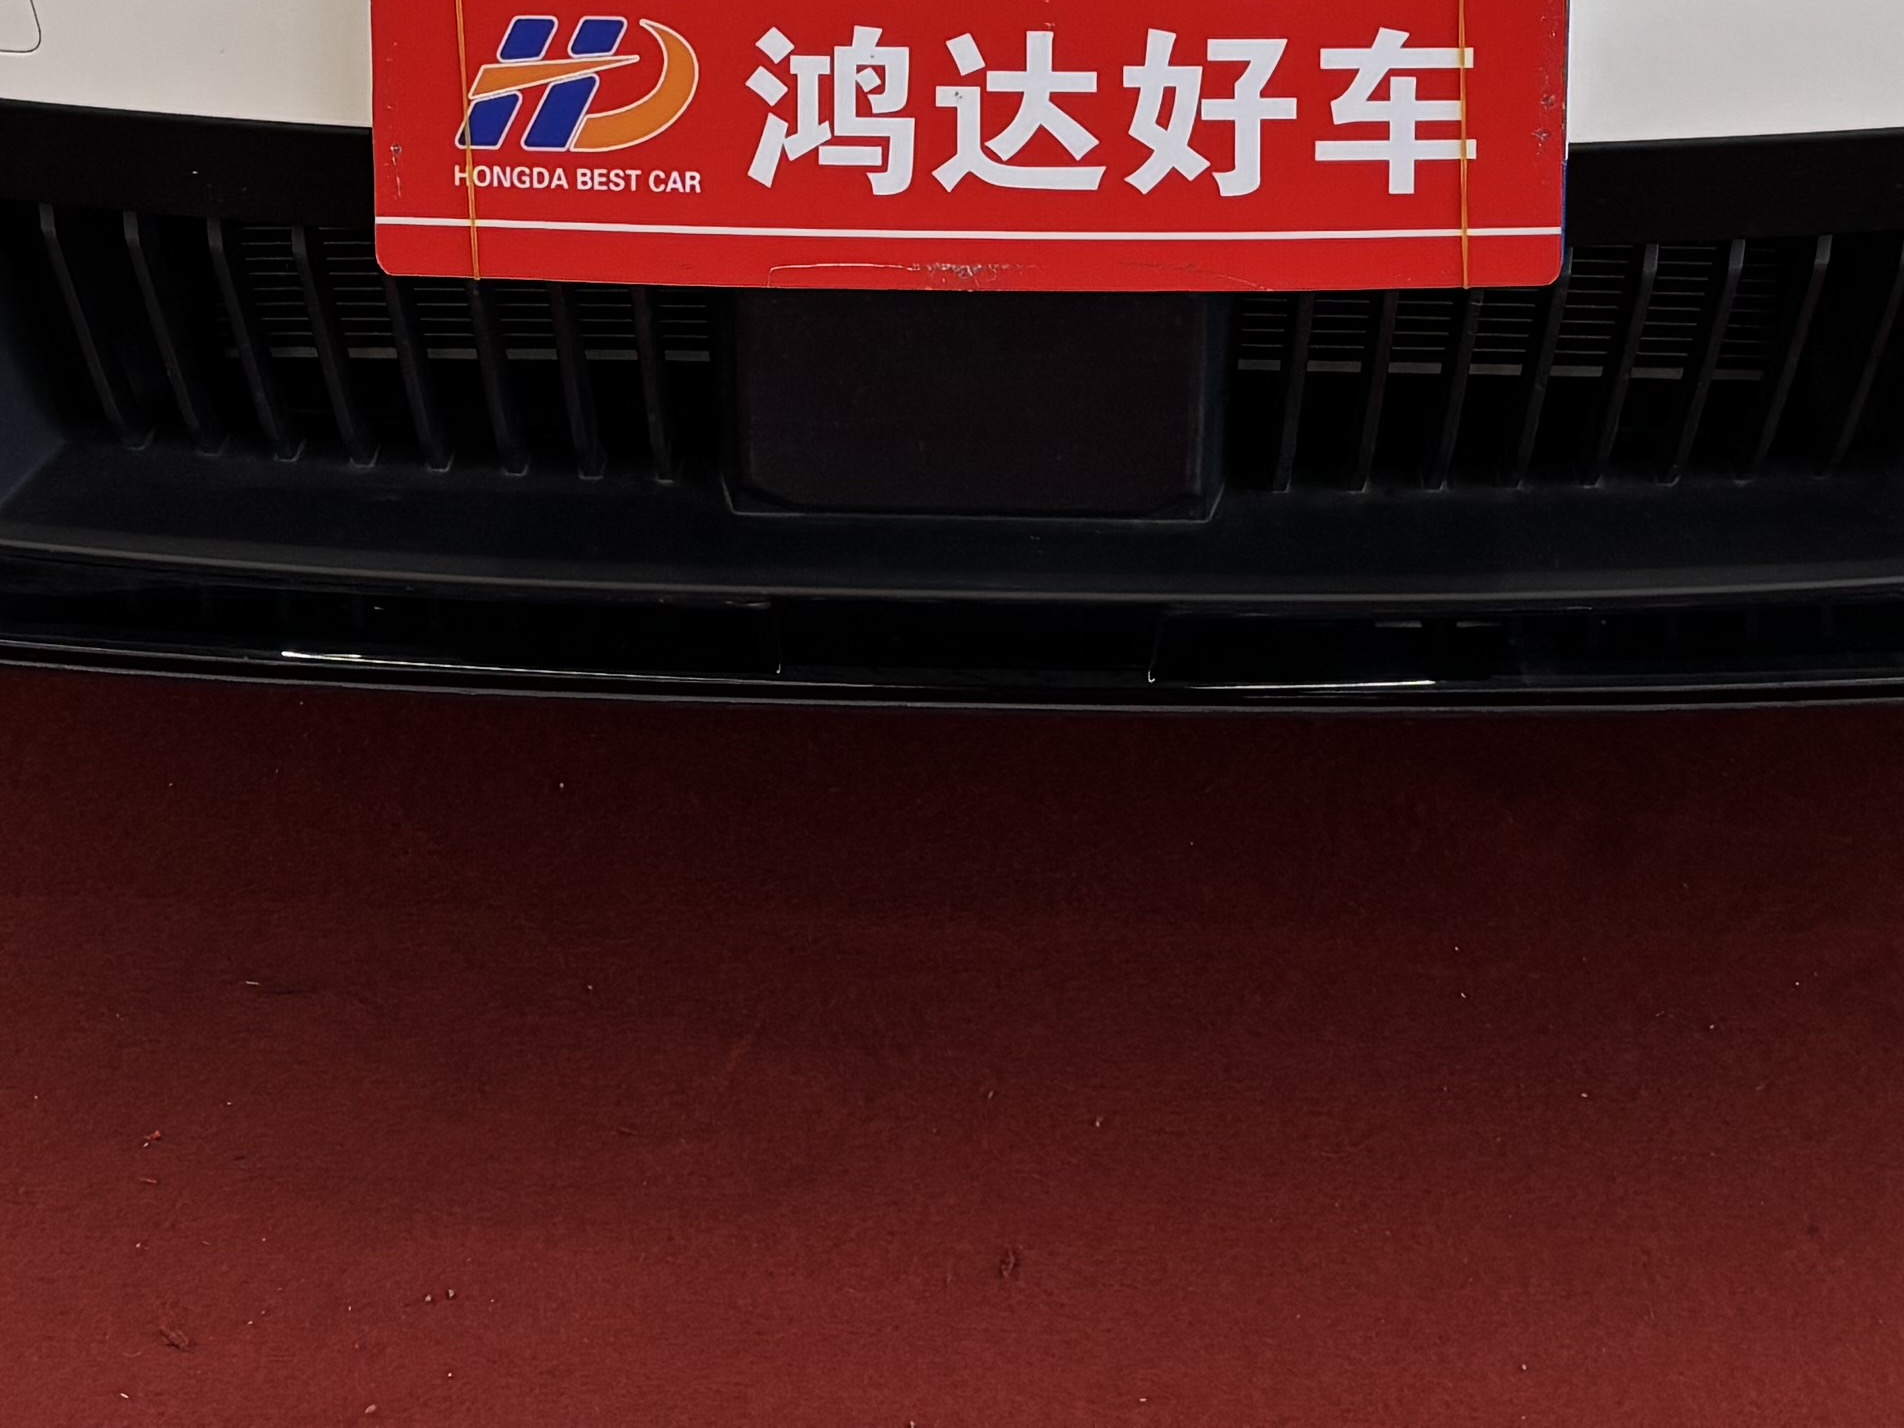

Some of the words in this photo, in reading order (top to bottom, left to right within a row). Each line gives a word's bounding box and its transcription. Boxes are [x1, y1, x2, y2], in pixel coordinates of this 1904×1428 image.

[744, 24, 1478, 198] 鸿达好车
[453, 164, 569, 191] HONGDA
[576, 168, 642, 192] BEST
[648, 170, 702, 194] CAR
